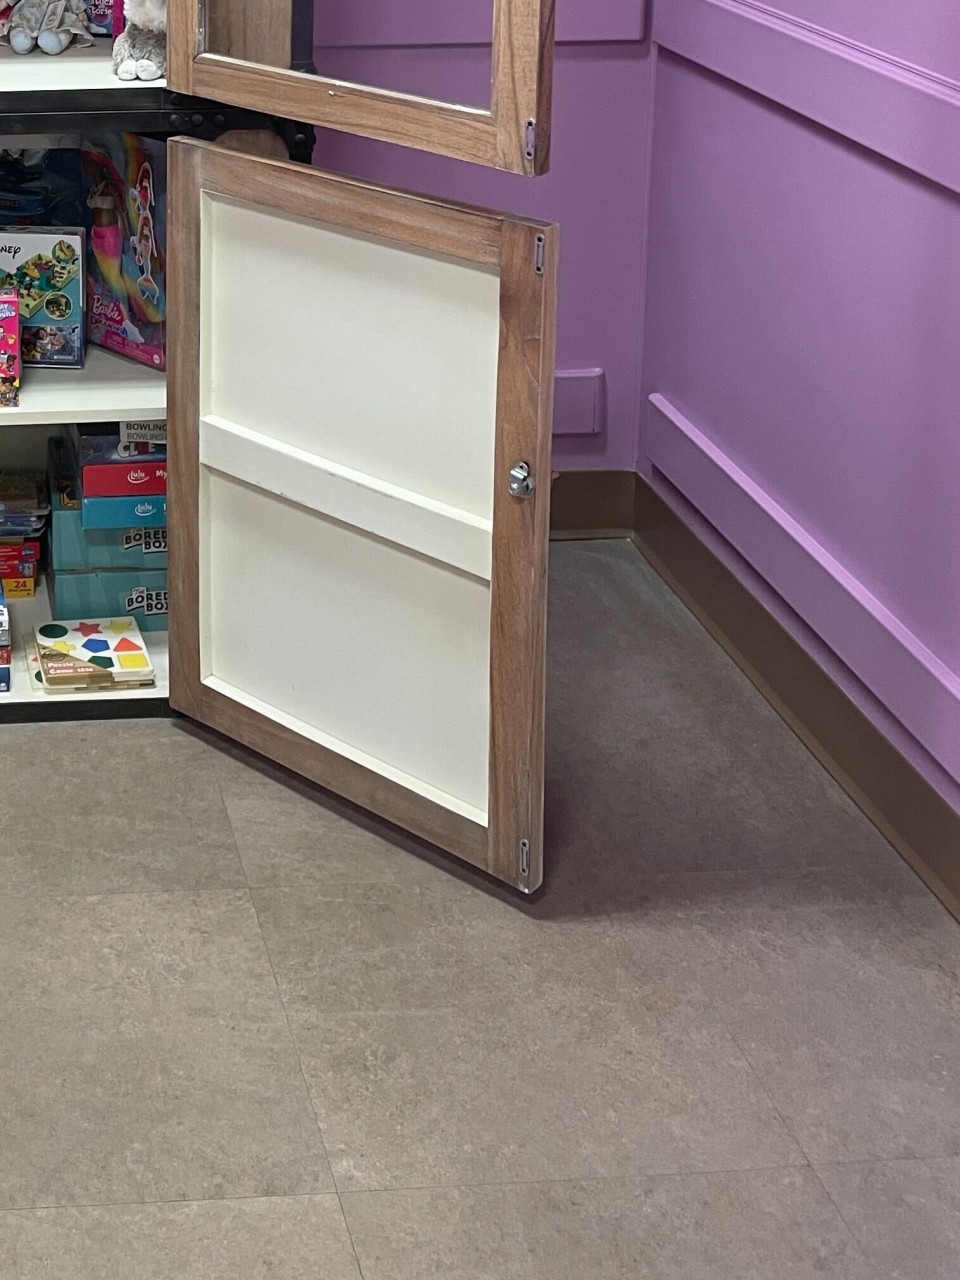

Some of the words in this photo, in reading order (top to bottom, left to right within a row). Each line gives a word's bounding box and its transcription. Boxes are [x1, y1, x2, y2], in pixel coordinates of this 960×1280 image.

[87, 5, 112, 14] Storie
[92, 295, 122, 320] Barbie
[126, 432, 163, 442] BOWLING
[125, 530, 167, 545] BORED
[14, 580, 28, 589] 24
[127, 592, 168, 608] BORED
